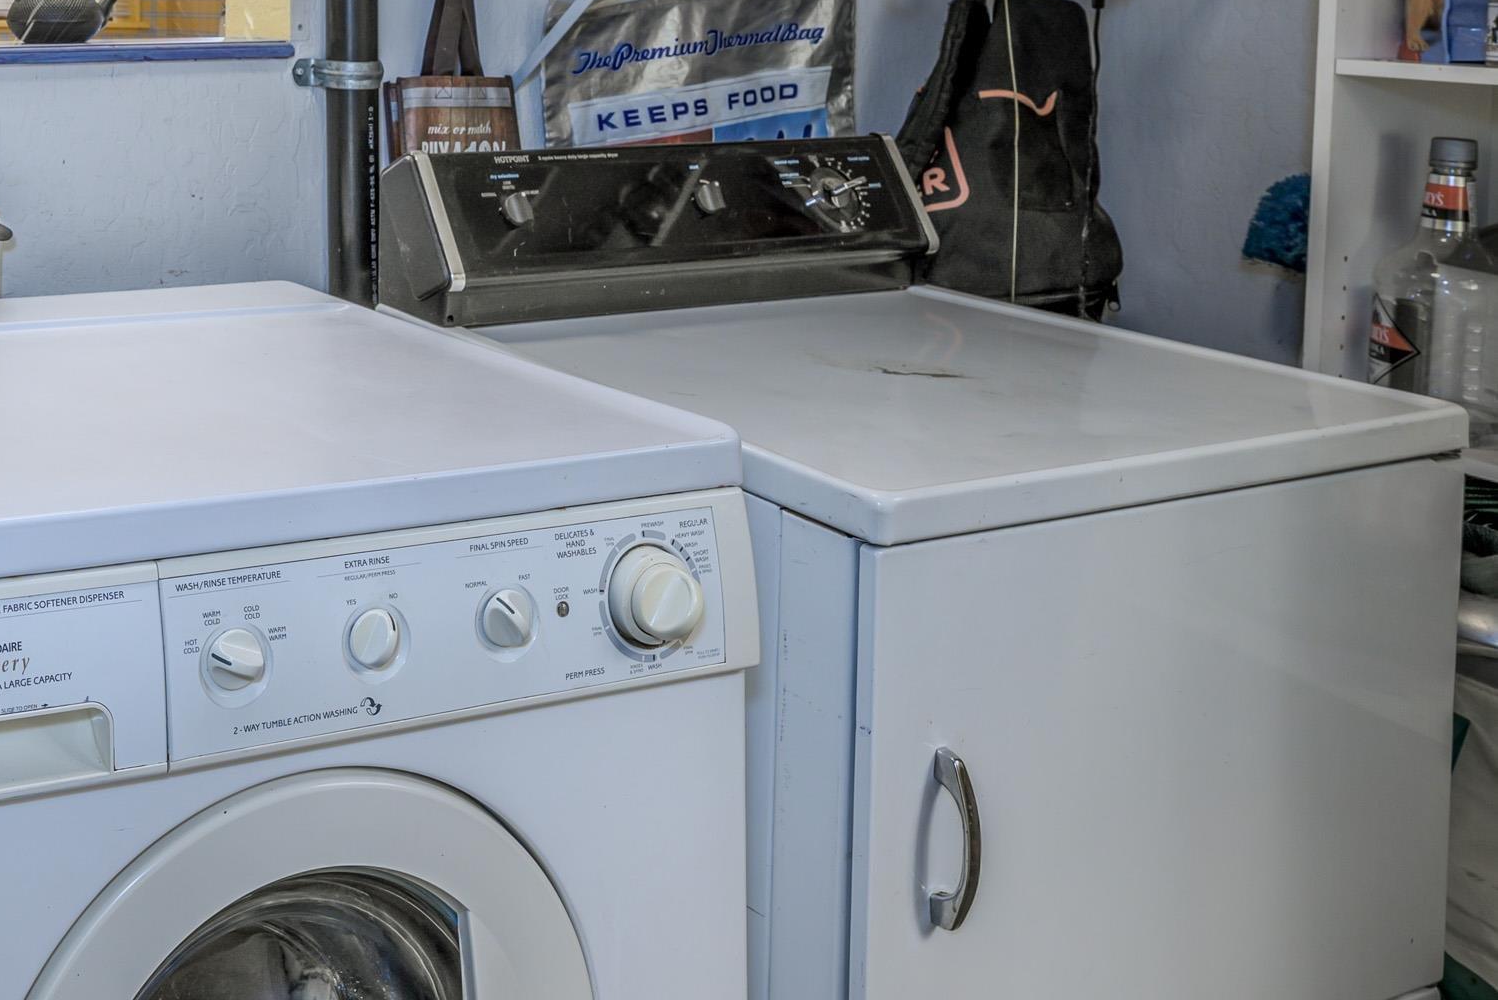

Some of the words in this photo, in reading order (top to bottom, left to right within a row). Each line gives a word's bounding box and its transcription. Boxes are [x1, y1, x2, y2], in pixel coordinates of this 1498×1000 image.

[572, 51, 612, 75] The
[611, 37, 709, 70] Premium
[705, 24, 781, 55] Thermal
[780, 22, 825, 45] Bag
[597, 98, 708, 131] KEEPS
[727, 83, 799, 110] FOOD
[428, 123, 450, 135] mix
[453, 126, 465, 135] or
[494, 154, 529, 164] HOTPOINT
[679, 518, 708, 528] REGULAR
[554, 530, 585, 540] DELICATES
[469, 543, 489, 552] FINAL
[490, 540, 506, 550] SPIN
[507, 537, 529, 547] SPEED
[565, 540, 585, 548] HAND
[556, 547, 597, 559] WASHABLES
[344, 559, 368, 569] EXTRA
[369, 556, 390, 565] RINSE
[175, 577, 226, 592] WASH/RINSE
[228, 570, 281, 585] TEMPERATURE
[518, 573, 531, 581] FAST
[465, 581, 488, 589] NORMAL
[3, 601, 33, 613] FABRIC
[34, 596, 78, 610] SOFTENER
[79, 591, 125, 604] DISPENSER
[202, 610, 221, 618] WARM
[244, 612, 261, 620] COLD
[204, 618, 221, 626] COLD
[268, 626, 286, 634] WARM
[183, 646, 200, 654] COLD
[647, 663, 662, 671] WASH
[565, 669, 584, 680] PERM
[585, 667, 605, 678] PRESS
[4, 678, 32, 690] LARGE
[33, 672, 72, 685] CAPACITY
[244, 723, 260, 733] WAY
[261, 718, 292, 729] TUMBLE
[293, 713, 322, 724] ACTION
[322, 706, 358, 719] WASHING
